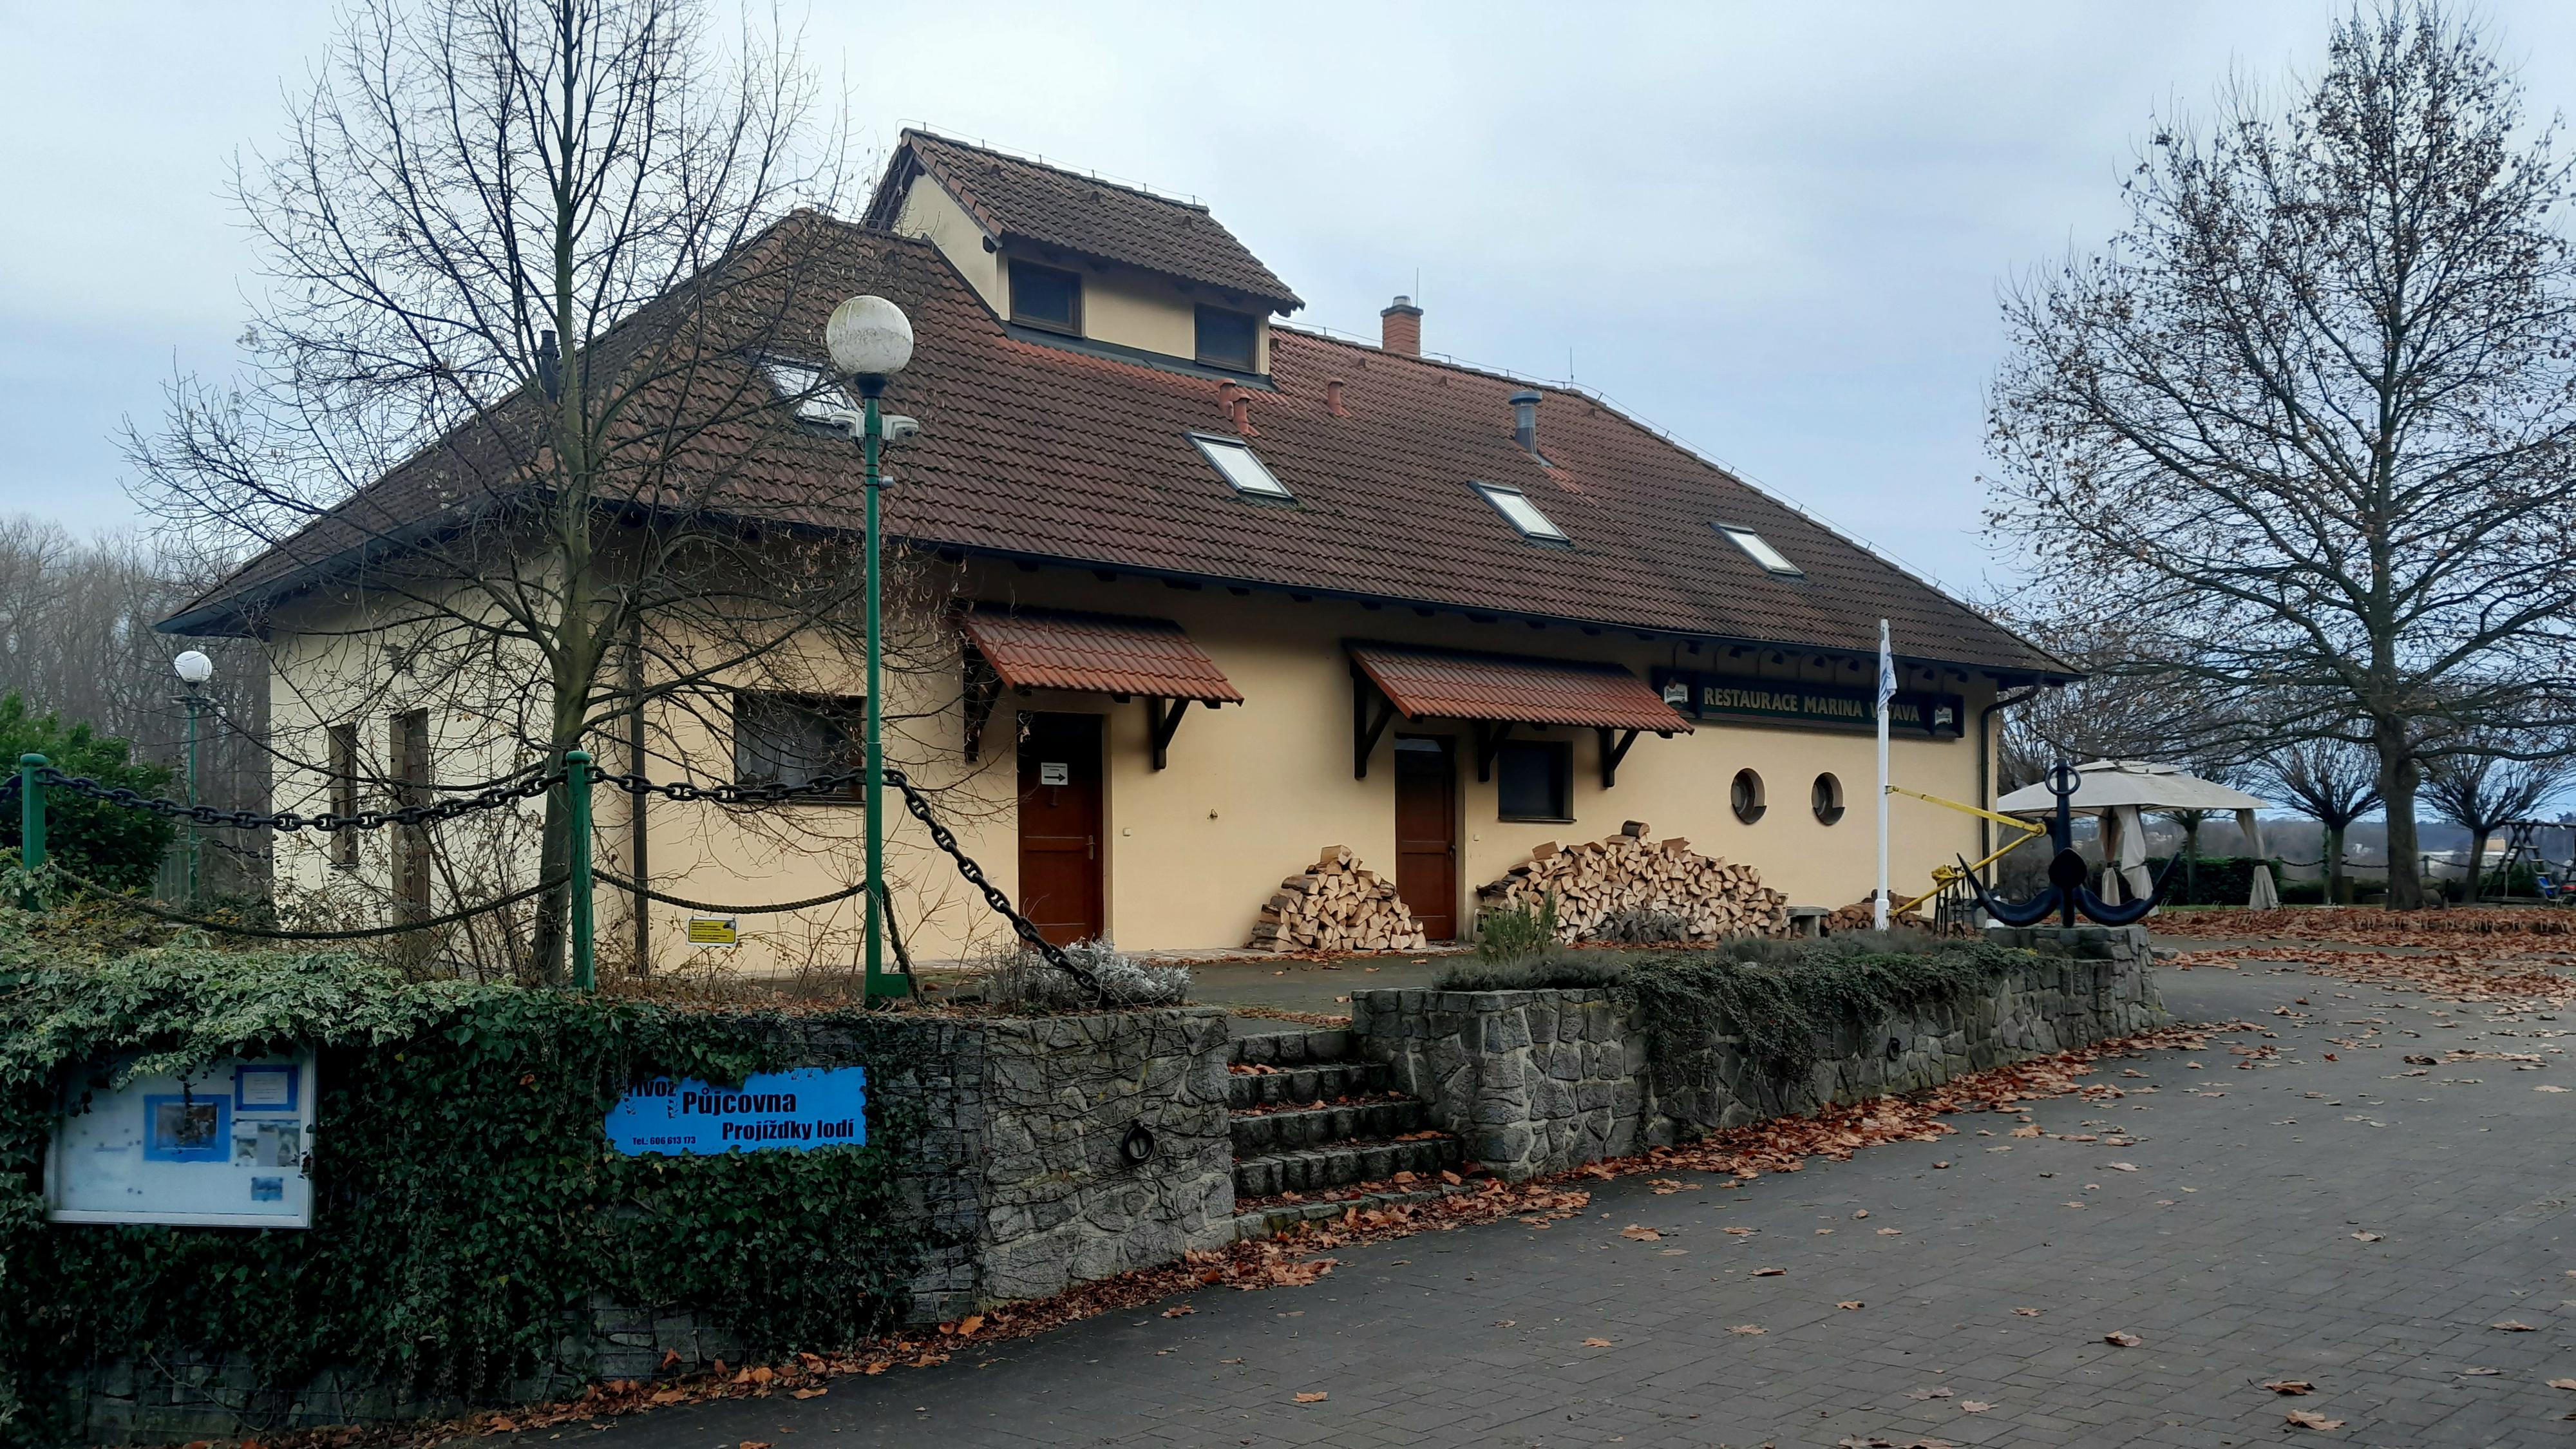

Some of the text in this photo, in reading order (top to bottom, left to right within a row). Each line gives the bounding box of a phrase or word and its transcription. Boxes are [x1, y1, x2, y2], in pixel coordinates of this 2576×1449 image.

[672, 645, 696, 659] 27
[1704, 687, 1798, 712] RESTAURACE
[1804, 696, 1863, 717] MARINA
[1870, 702, 1920, 721] VTAVA
[683, 1087, 797, 1116] Půjcovna
[722, 1119, 855, 1141] Projížďky lodí
